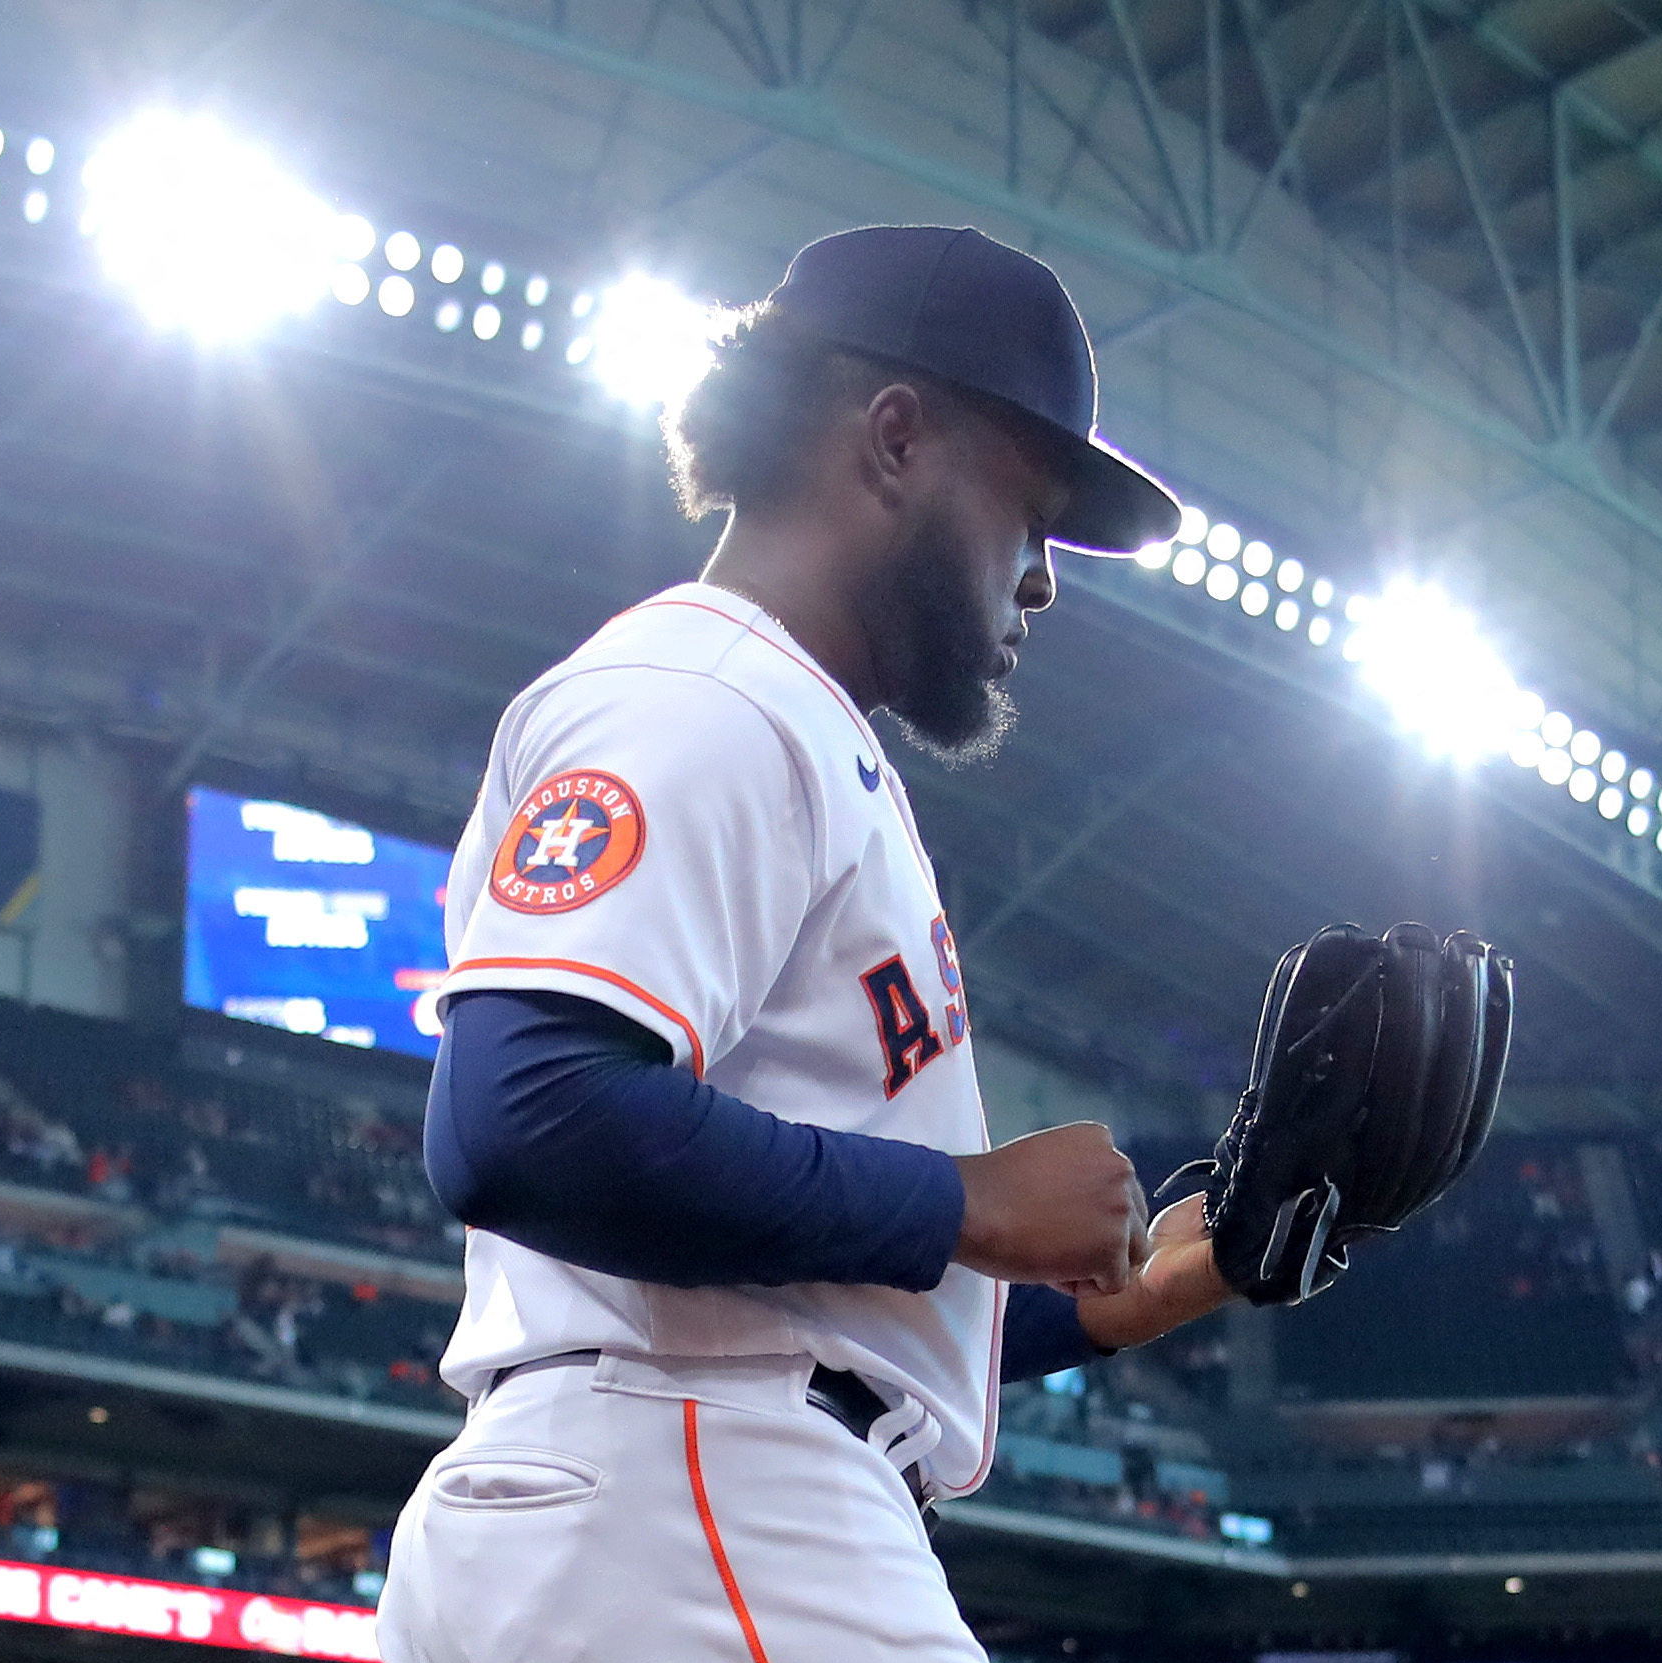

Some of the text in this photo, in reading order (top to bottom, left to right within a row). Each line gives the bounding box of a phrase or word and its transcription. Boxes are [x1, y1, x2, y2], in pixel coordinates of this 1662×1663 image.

[522, 778, 632, 822] HOUSTON
[526, 818, 595, 867] H
[498, 873, 596, 905] ASTROS
